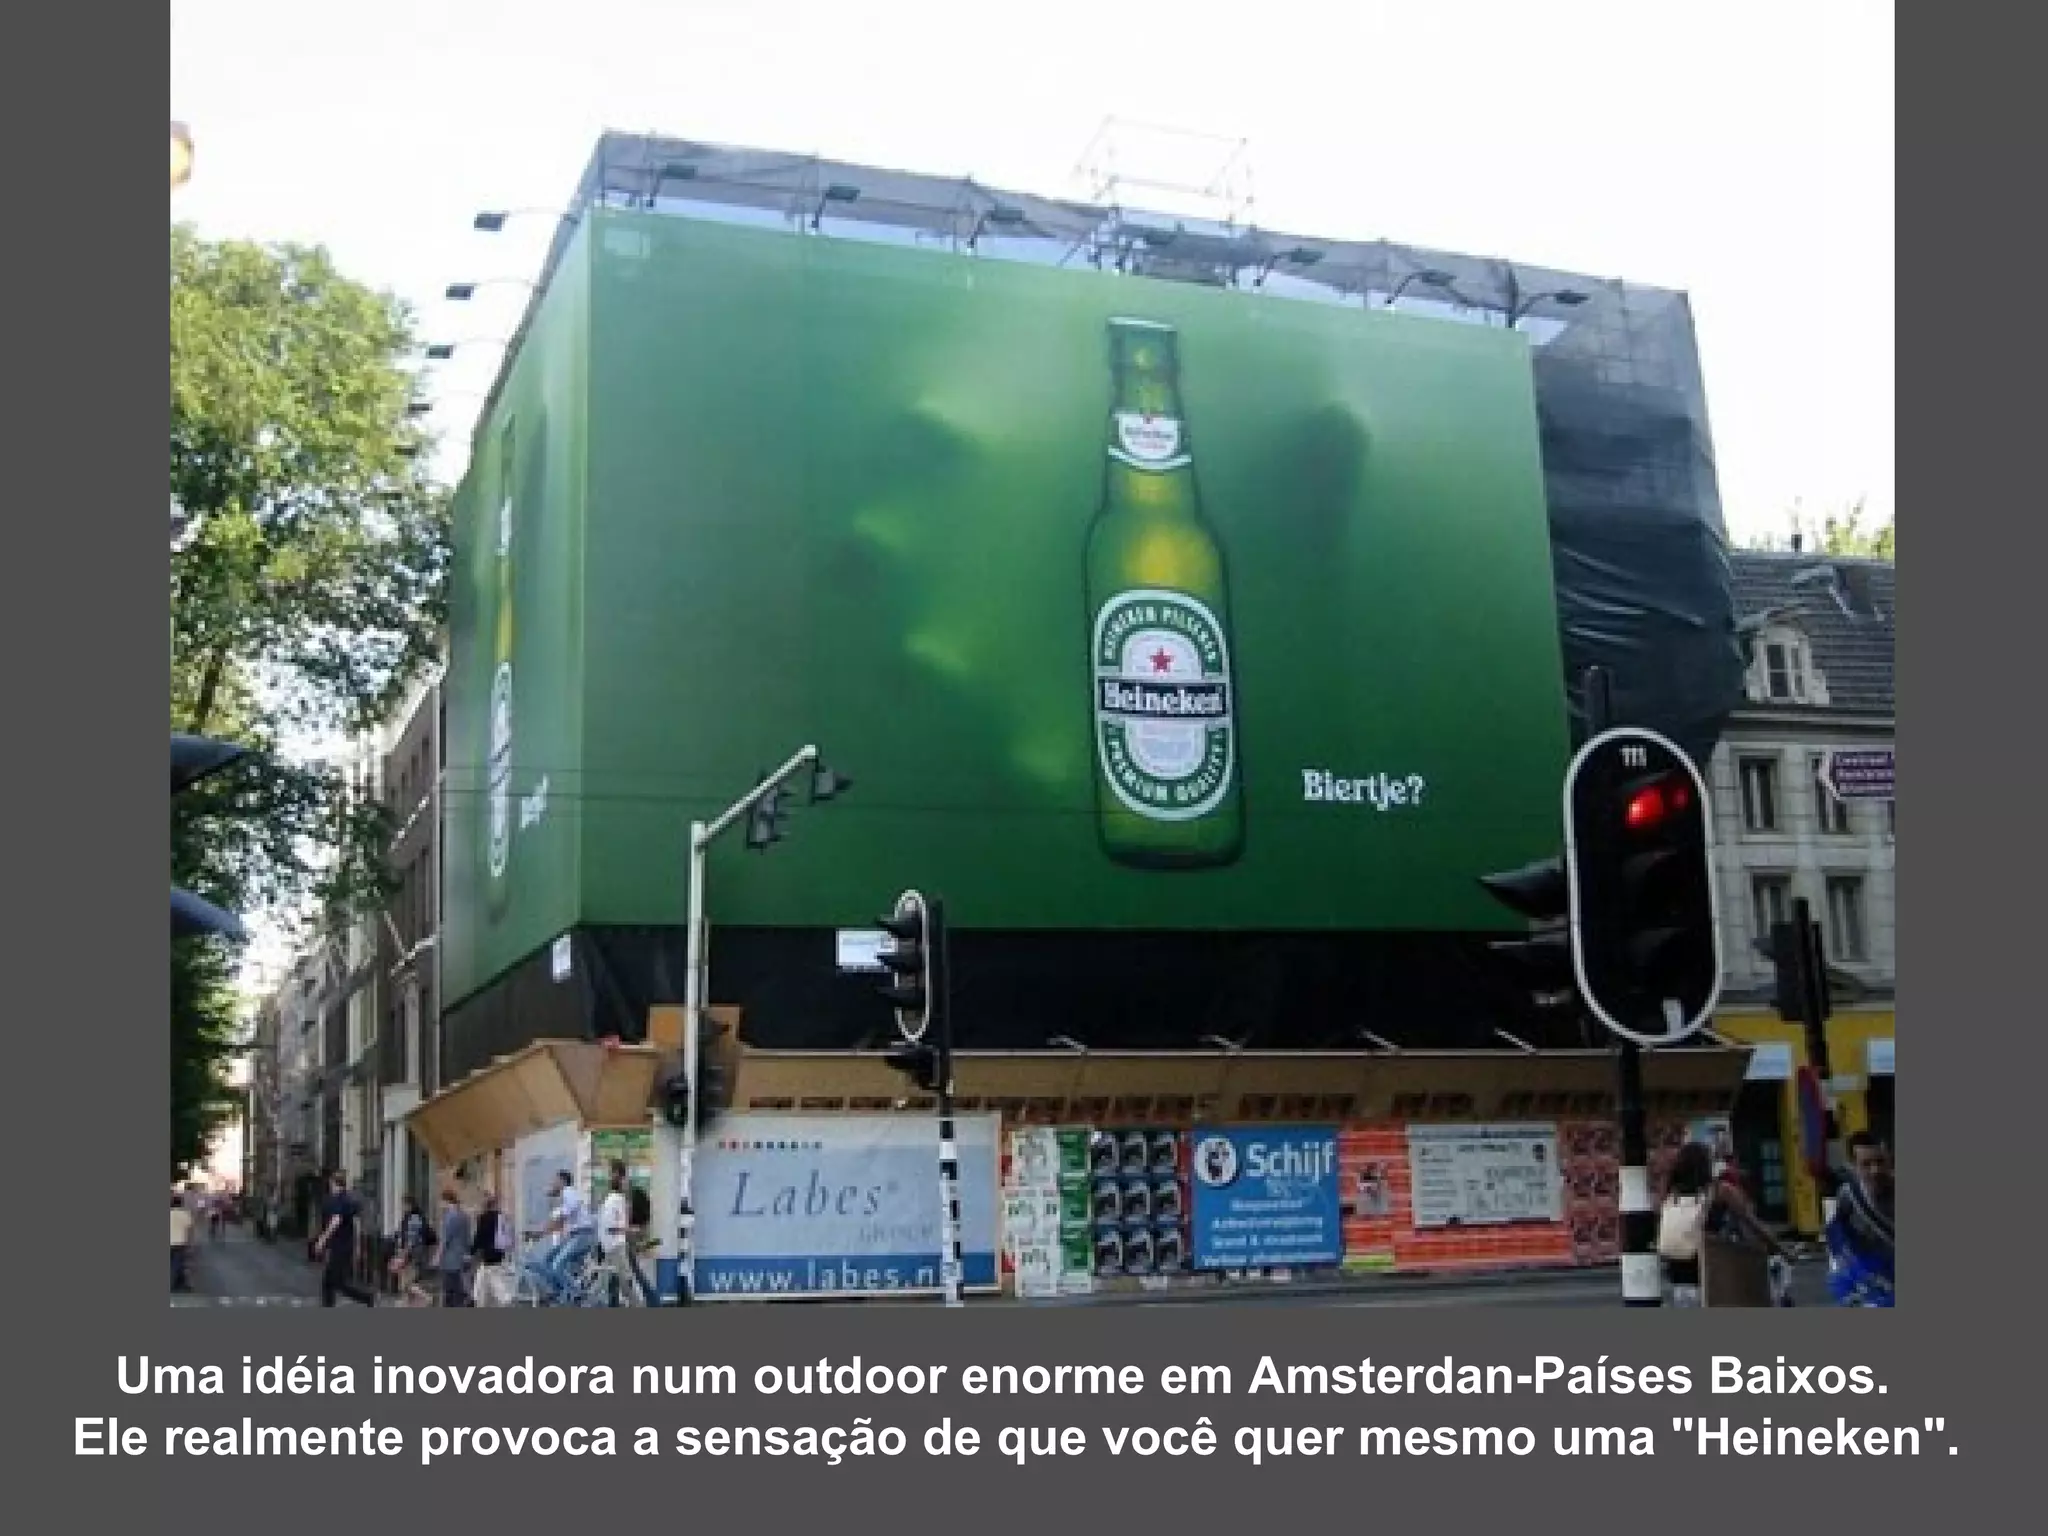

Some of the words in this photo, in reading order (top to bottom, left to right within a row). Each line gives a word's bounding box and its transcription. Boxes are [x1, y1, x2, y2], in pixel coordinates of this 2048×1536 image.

[1104, 681, 1222, 716] Heineken
[1301, 768, 1426, 812] Biertje?
[1246, 1140, 1335, 1186] Schijf
[728, 1168, 884, 1218] Labes
[709, 1257, 940, 1292] www.labes.n
